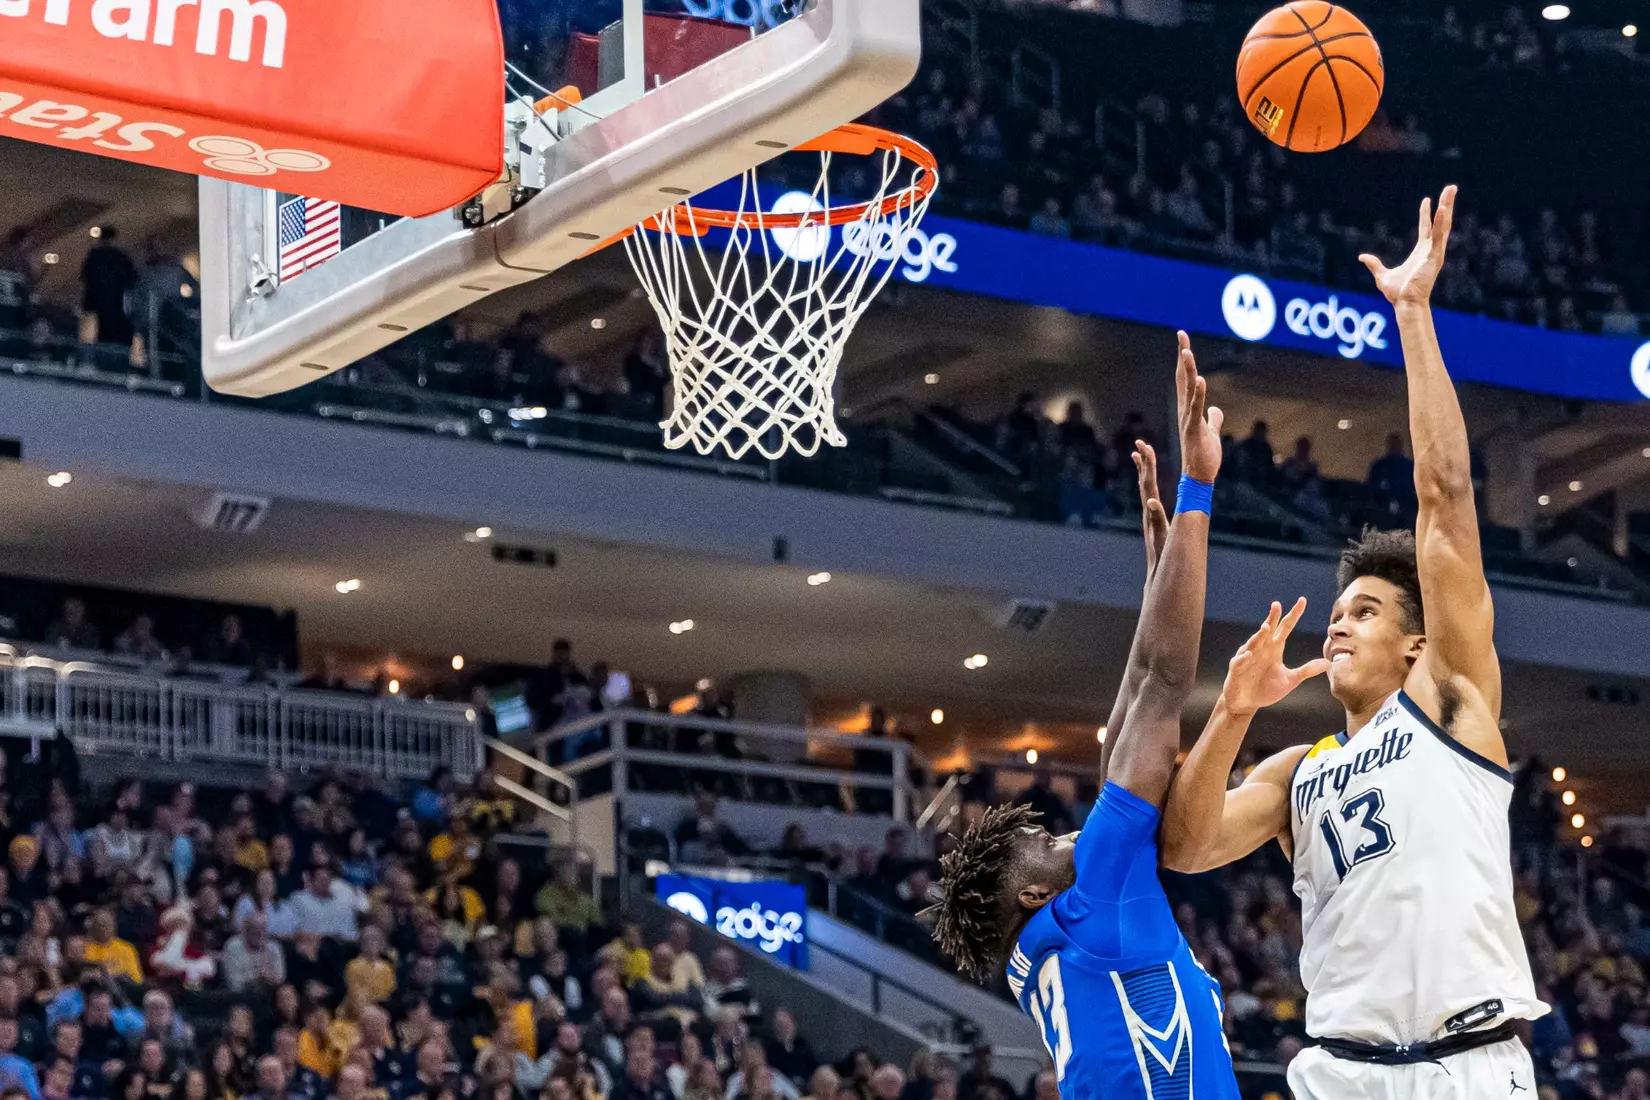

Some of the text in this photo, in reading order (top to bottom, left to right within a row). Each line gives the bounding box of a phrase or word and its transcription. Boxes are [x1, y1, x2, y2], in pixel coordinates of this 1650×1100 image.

[842, 214, 958, 282] edge
[1284, 294, 1388, 359] edge
[1320, 787, 1396, 884] 13
